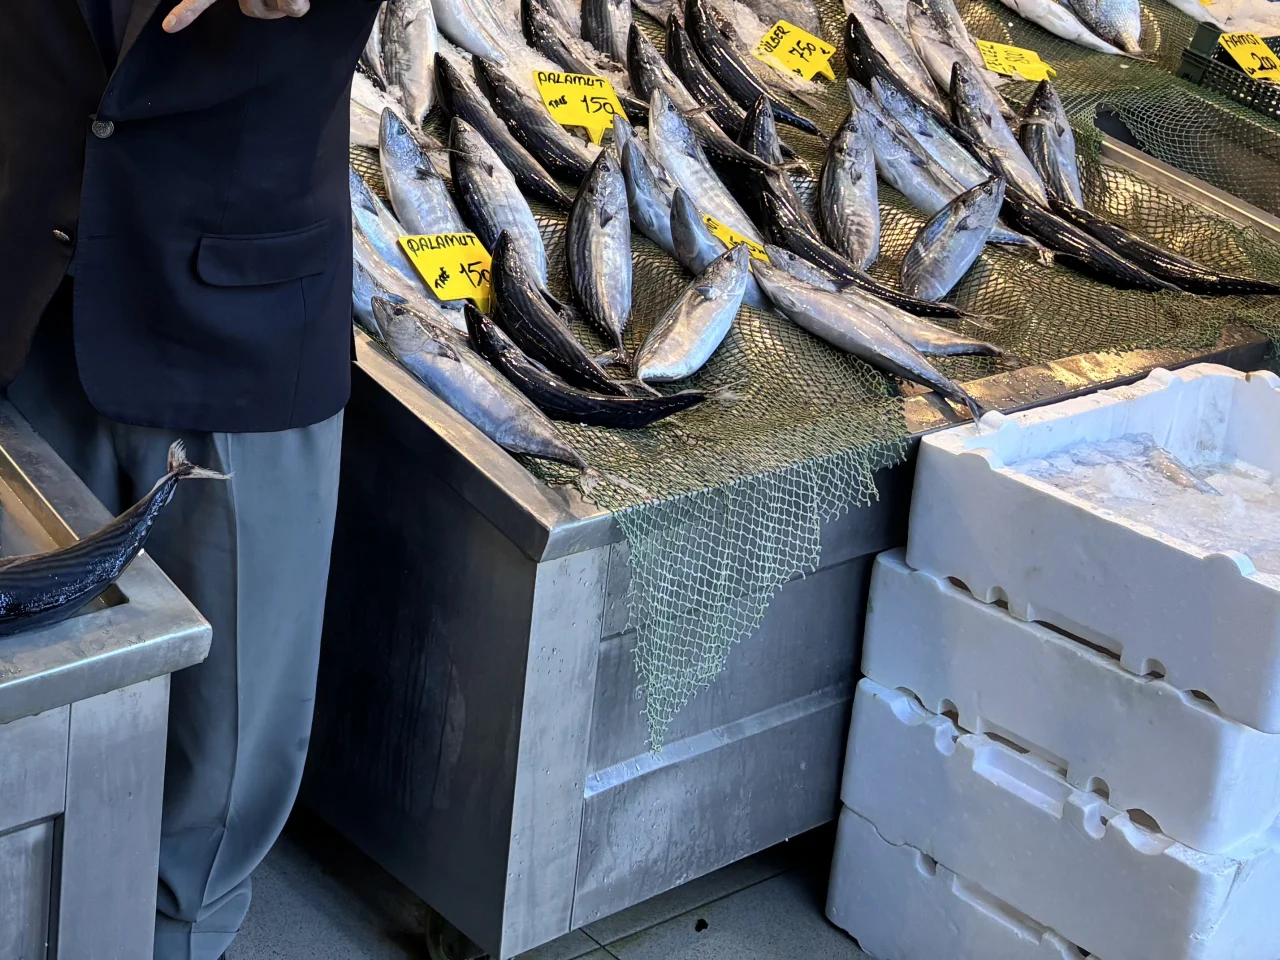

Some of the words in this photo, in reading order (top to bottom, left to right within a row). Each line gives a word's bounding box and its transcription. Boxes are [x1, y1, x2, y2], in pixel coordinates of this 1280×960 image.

[788, 40, 817, 63] 750
[537, 71, 606, 89] PALAMUT
[580, 94, 619, 115] 150
[406, 234, 477, 257] PALAMUT
